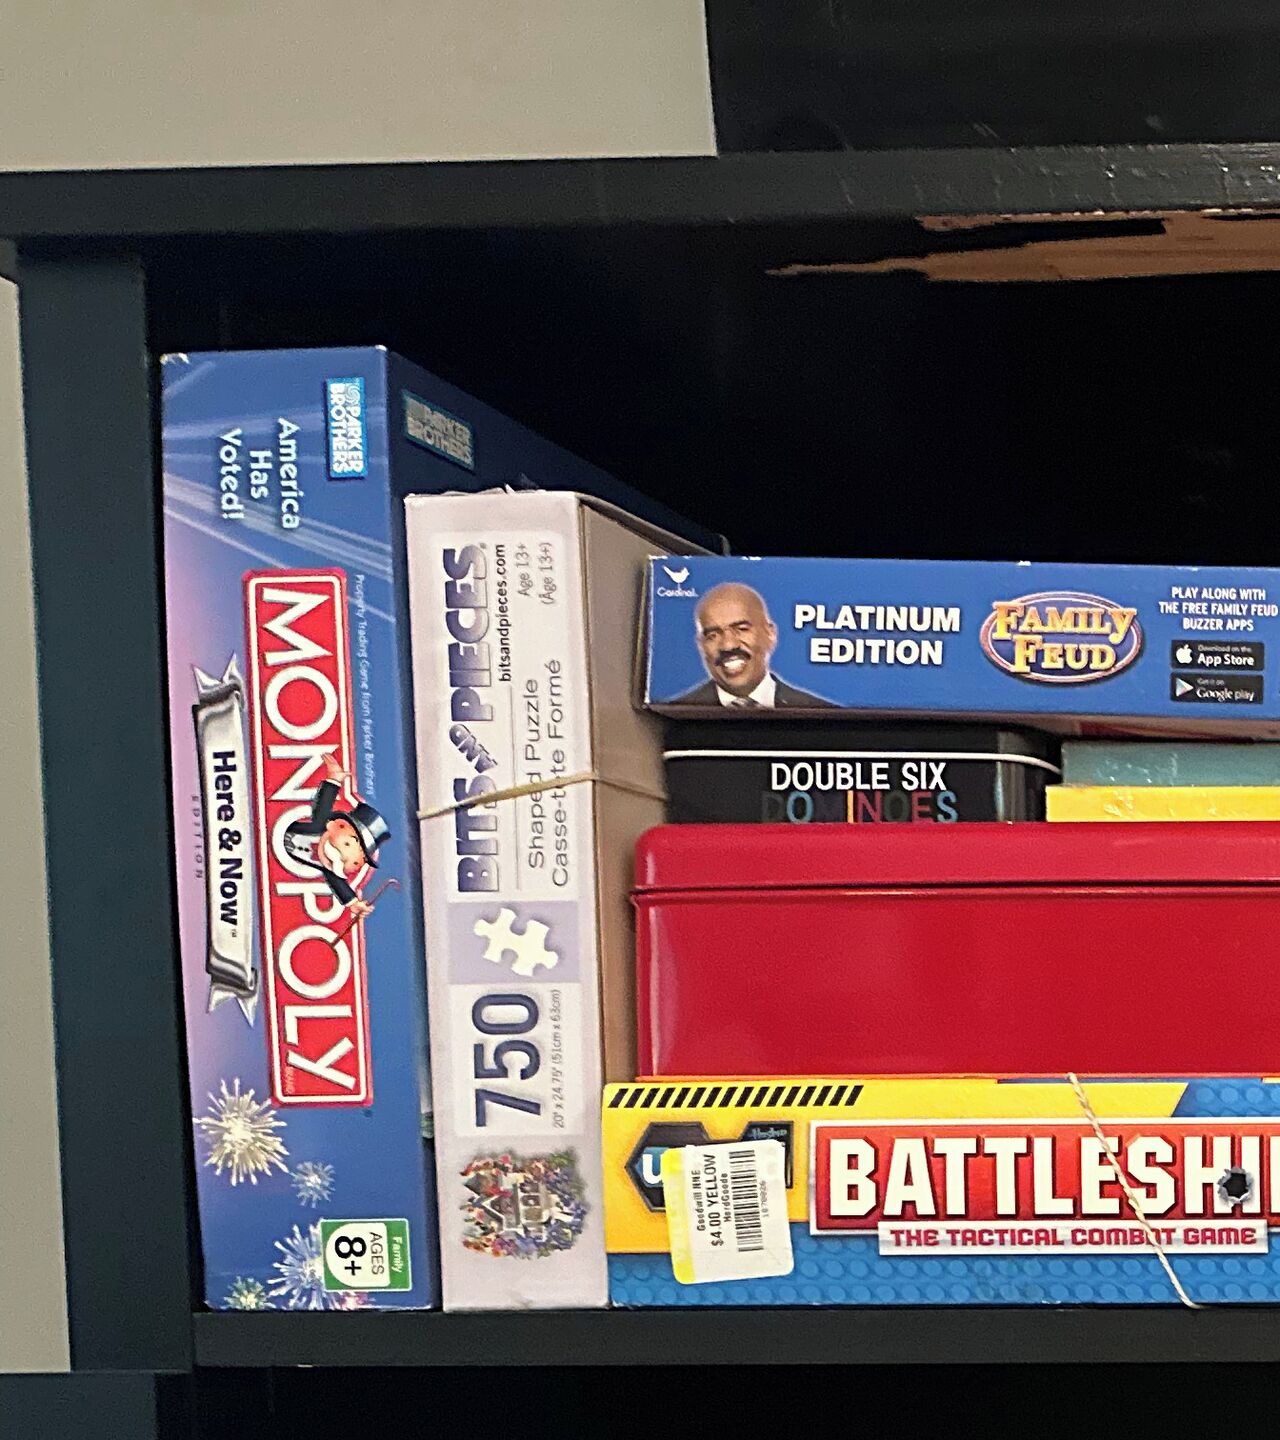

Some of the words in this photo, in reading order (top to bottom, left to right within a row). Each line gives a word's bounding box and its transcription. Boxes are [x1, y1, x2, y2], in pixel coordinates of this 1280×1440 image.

[219, 428, 245, 520] Voted!
[249, 450, 272, 499] Has
[278, 417, 304, 529] America
[442, 544, 493, 722] PIECES
[494, 544, 511, 682] bitsandpieces.com
[794, 604, 961, 632] PLATINUM
[993, 601, 1137, 644] FAMILY
[810, 637, 943, 665] EDITION
[1009, 634, 1117, 674] FEUD
[1197, 653, 1222, 668] App
[1224, 653, 1254, 666] Store
[524, 678, 540, 761] Puzzle
[548, 659, 565, 740] Formé
[212, 750, 236, 822] Here
[771, 762, 889, 790] DOUBLE
[901, 762, 947, 790] SIX
[218, 828, 242, 851] &
[527, 771, 545, 868] Shaped
[215, 859, 244, 926] Now
[471, 993, 543, 1128] 750
[704, 1154, 718, 1207] YELLOW
[708, 1212, 724, 1246] $4.00
[891, 1228, 938, 1246] THE
[949, 1228, 1064, 1246] TACTICAL
[1183, 1227, 1257, 1245] GAME
[333, 1235, 367, 1277] 8+
[369, 1232, 386, 1276] AGES
